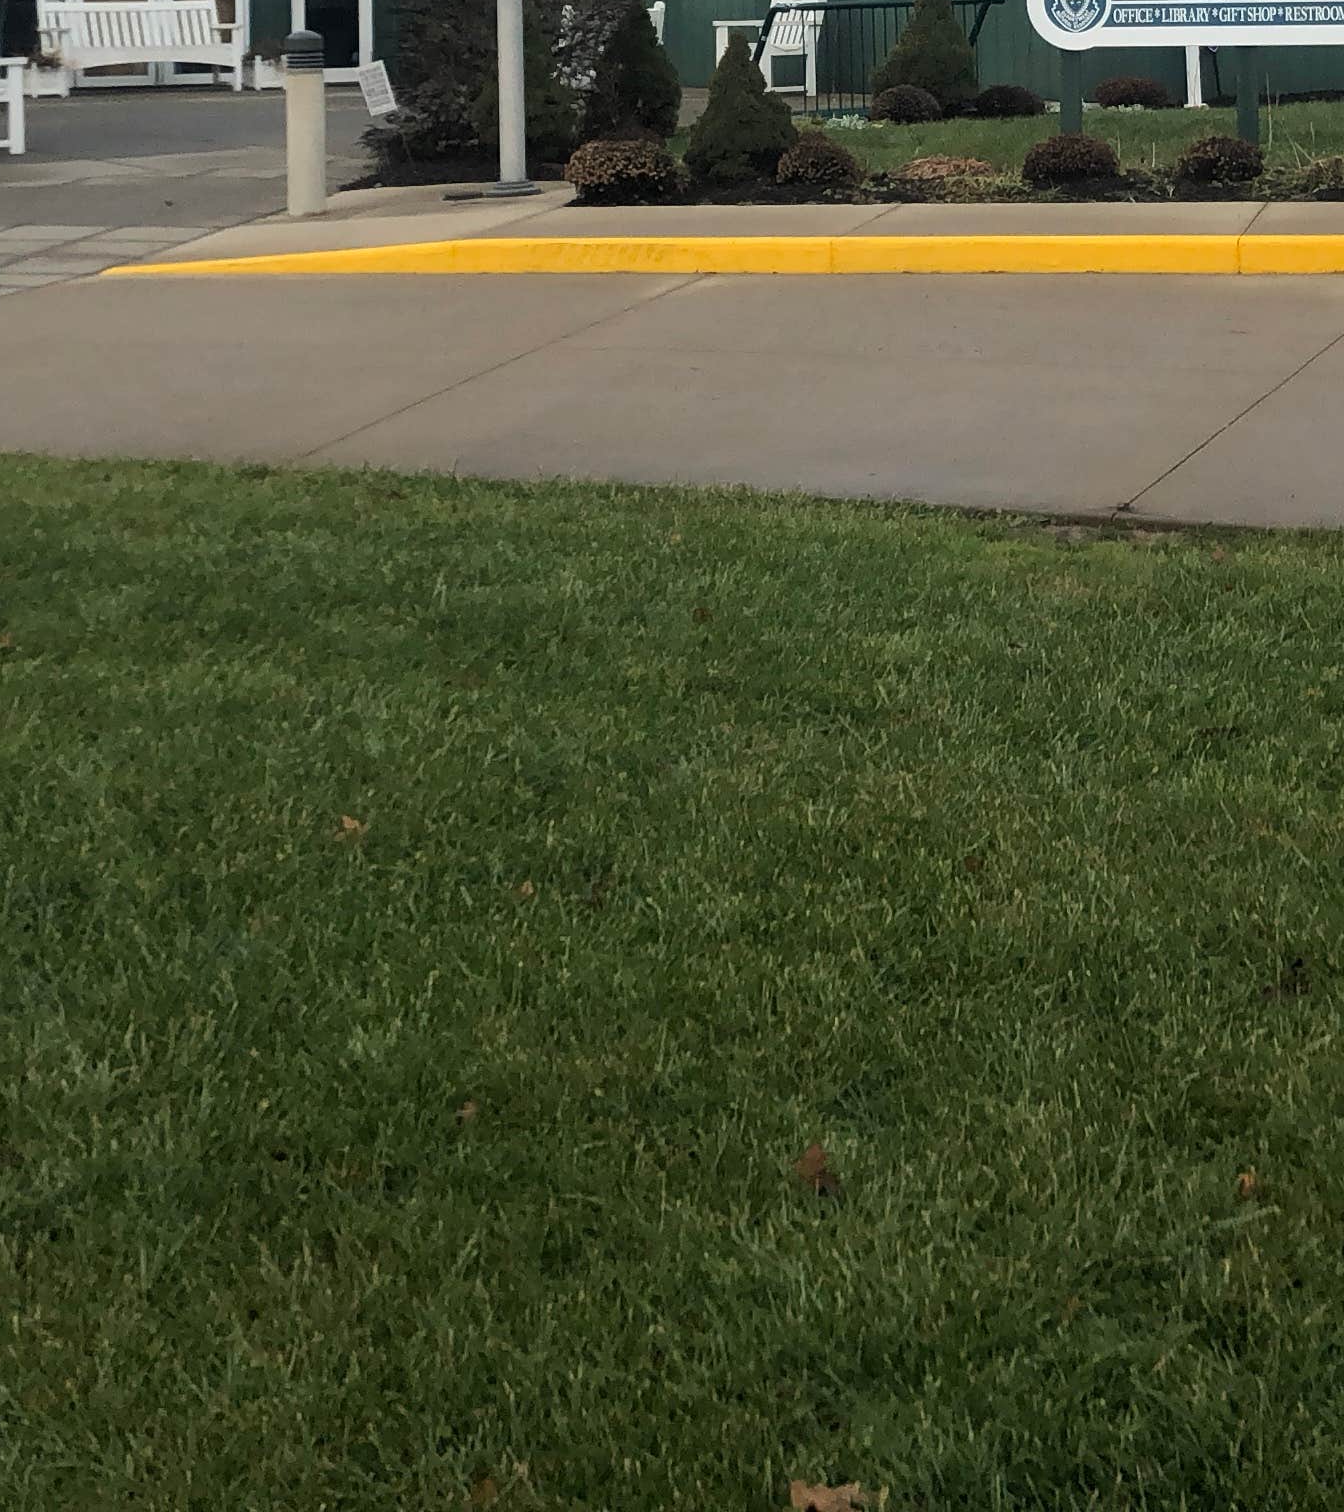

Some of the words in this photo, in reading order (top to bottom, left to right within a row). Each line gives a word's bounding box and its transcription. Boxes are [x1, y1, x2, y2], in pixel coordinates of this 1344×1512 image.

[1112, 8, 1154, 24] OFFICE
[1161, 7, 1210, 23] LIBRARY
[1219, 6, 1247, 22] GIFT
[1247, 6, 1277, 22] SHOP
